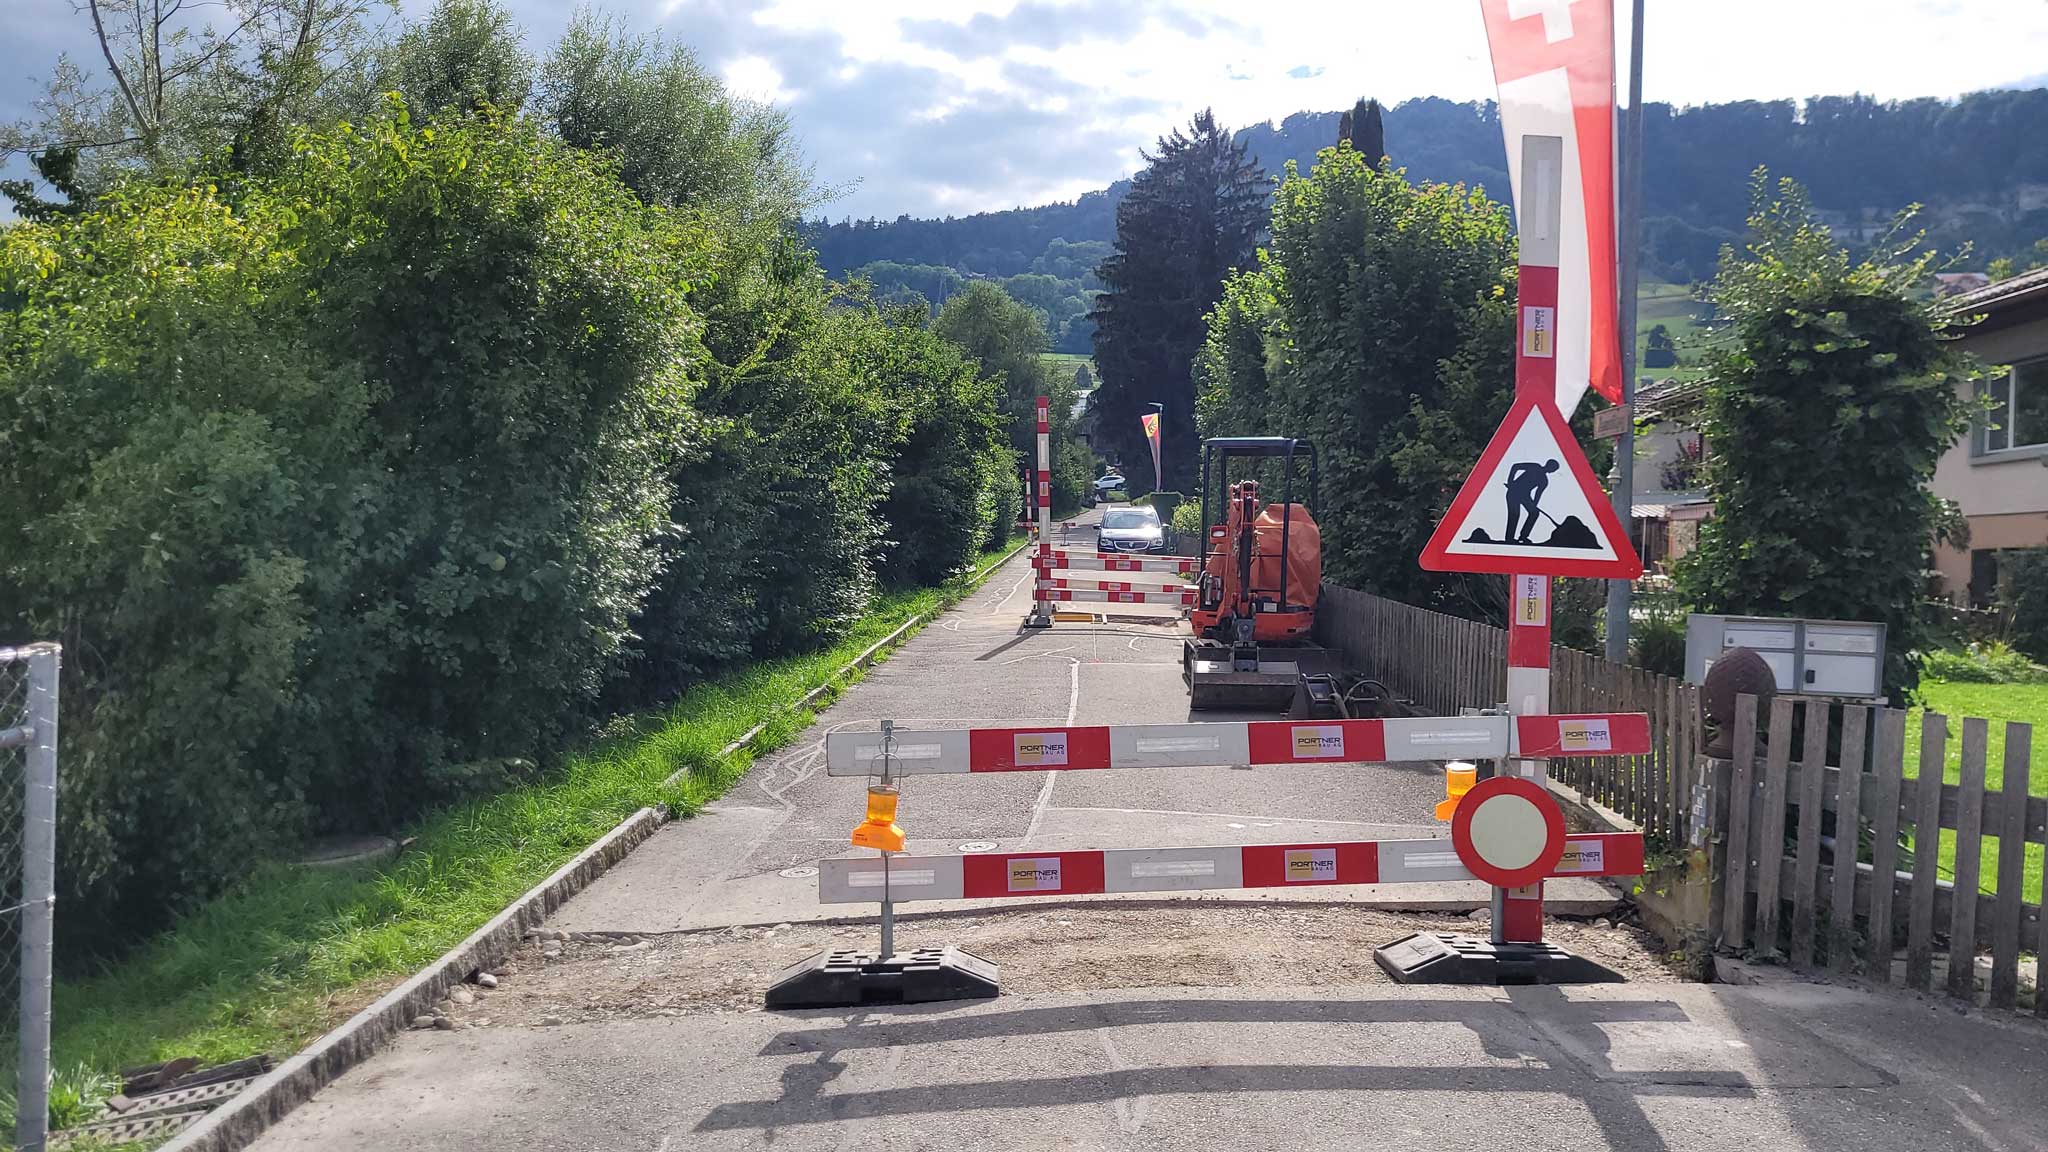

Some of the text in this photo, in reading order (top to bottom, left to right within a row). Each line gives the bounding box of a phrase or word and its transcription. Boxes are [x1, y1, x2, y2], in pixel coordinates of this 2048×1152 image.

[1565, 730, 1607, 738] PORTNER
[1297, 737, 1342, 745] PORTNER
[1020, 744, 1065, 752] PORTNER
[1290, 860, 1334, 868] PORTNER
[1013, 869, 1058, 877] PORTNER
